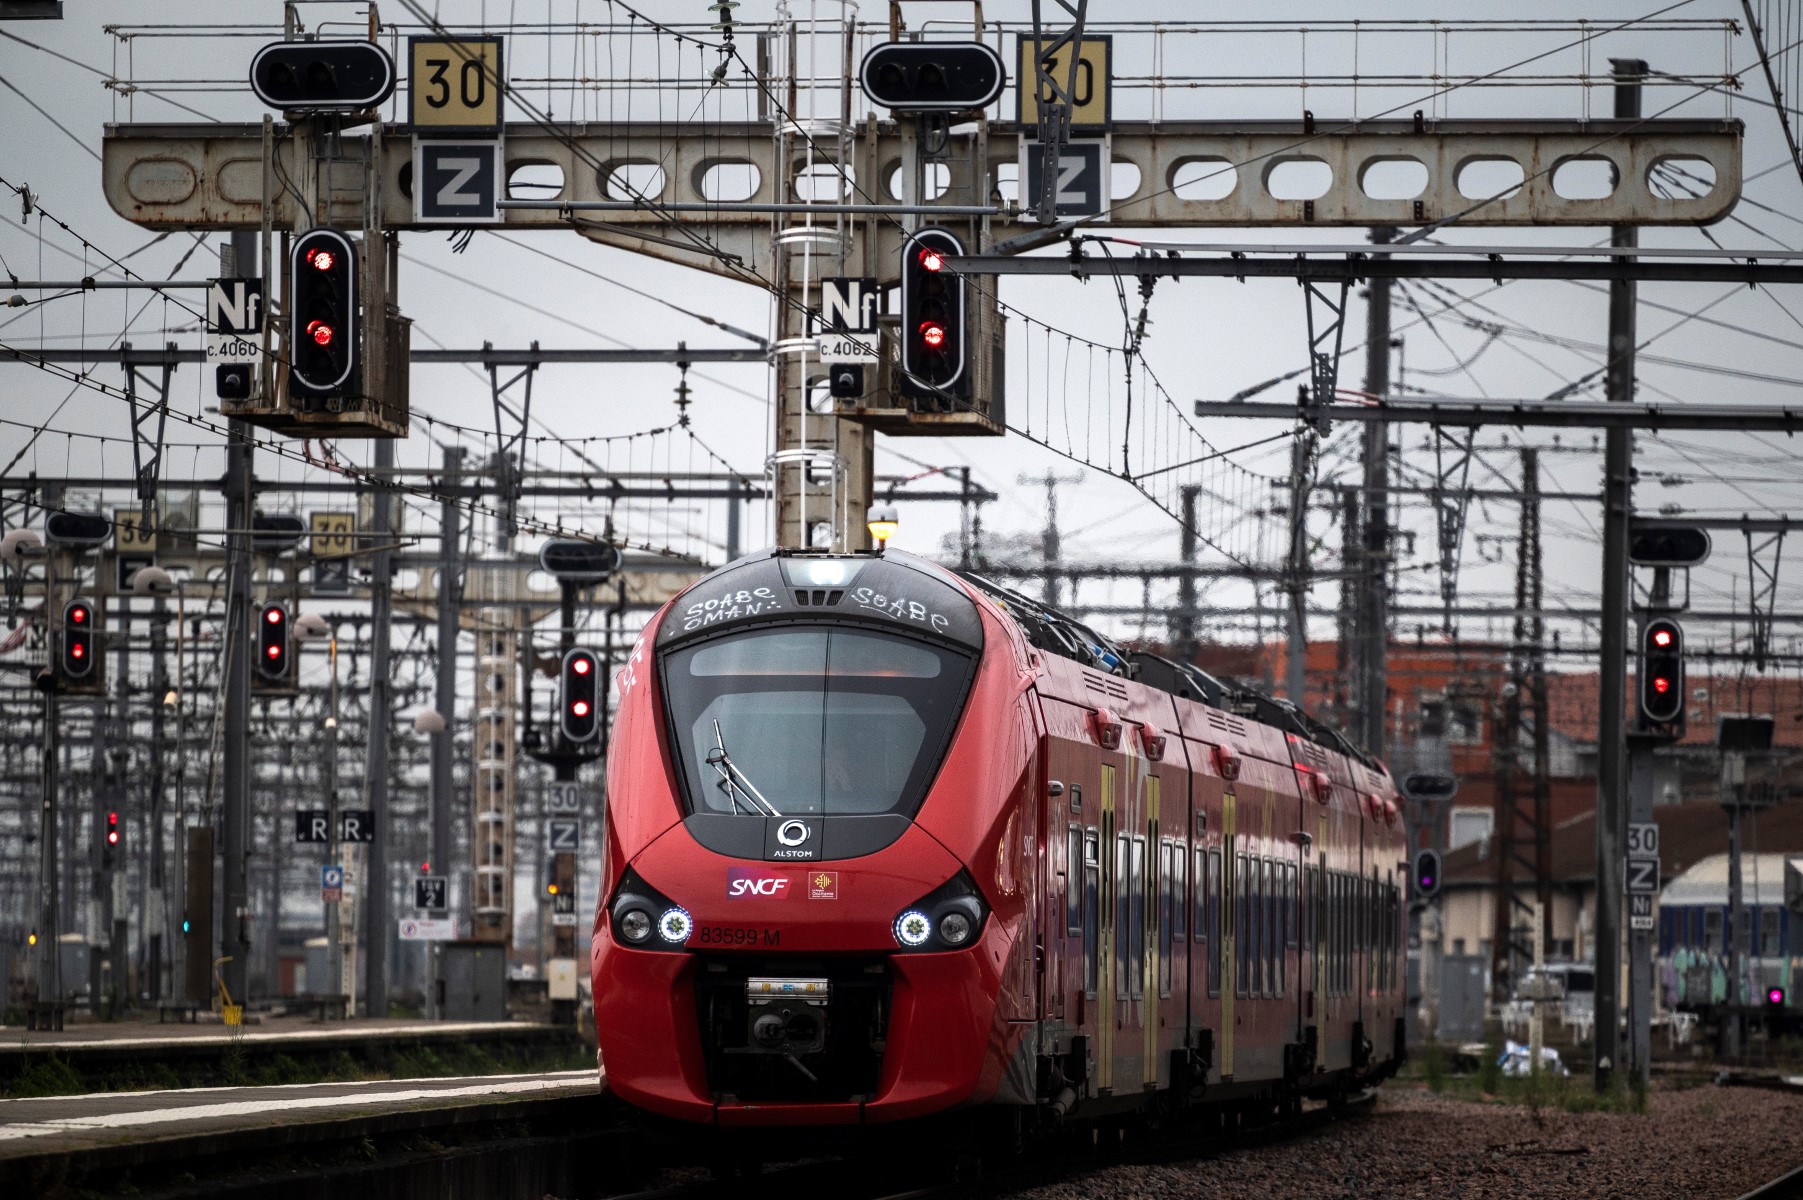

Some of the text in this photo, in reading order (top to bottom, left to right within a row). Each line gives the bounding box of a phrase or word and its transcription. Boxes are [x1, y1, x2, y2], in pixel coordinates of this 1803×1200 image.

[426, 59, 485, 108] 30
[437, 157, 480, 205] Z
[1042, 156, 1086, 204] Z
[208, 282, 260, 330] Nf
[822, 281, 875, 330] Nf
[319, 522, 346, 547] 30
[552, 786, 577, 807] 30
[312, 818, 327, 839] R
[345, 818, 360, 839] R
[553, 824, 577, 847] Z
[1628, 828, 1656, 851] 30
[729, 878, 788, 896] SNCF
[1630, 862, 1653, 889] Z
[701, 927, 780, 945] 83599 M
